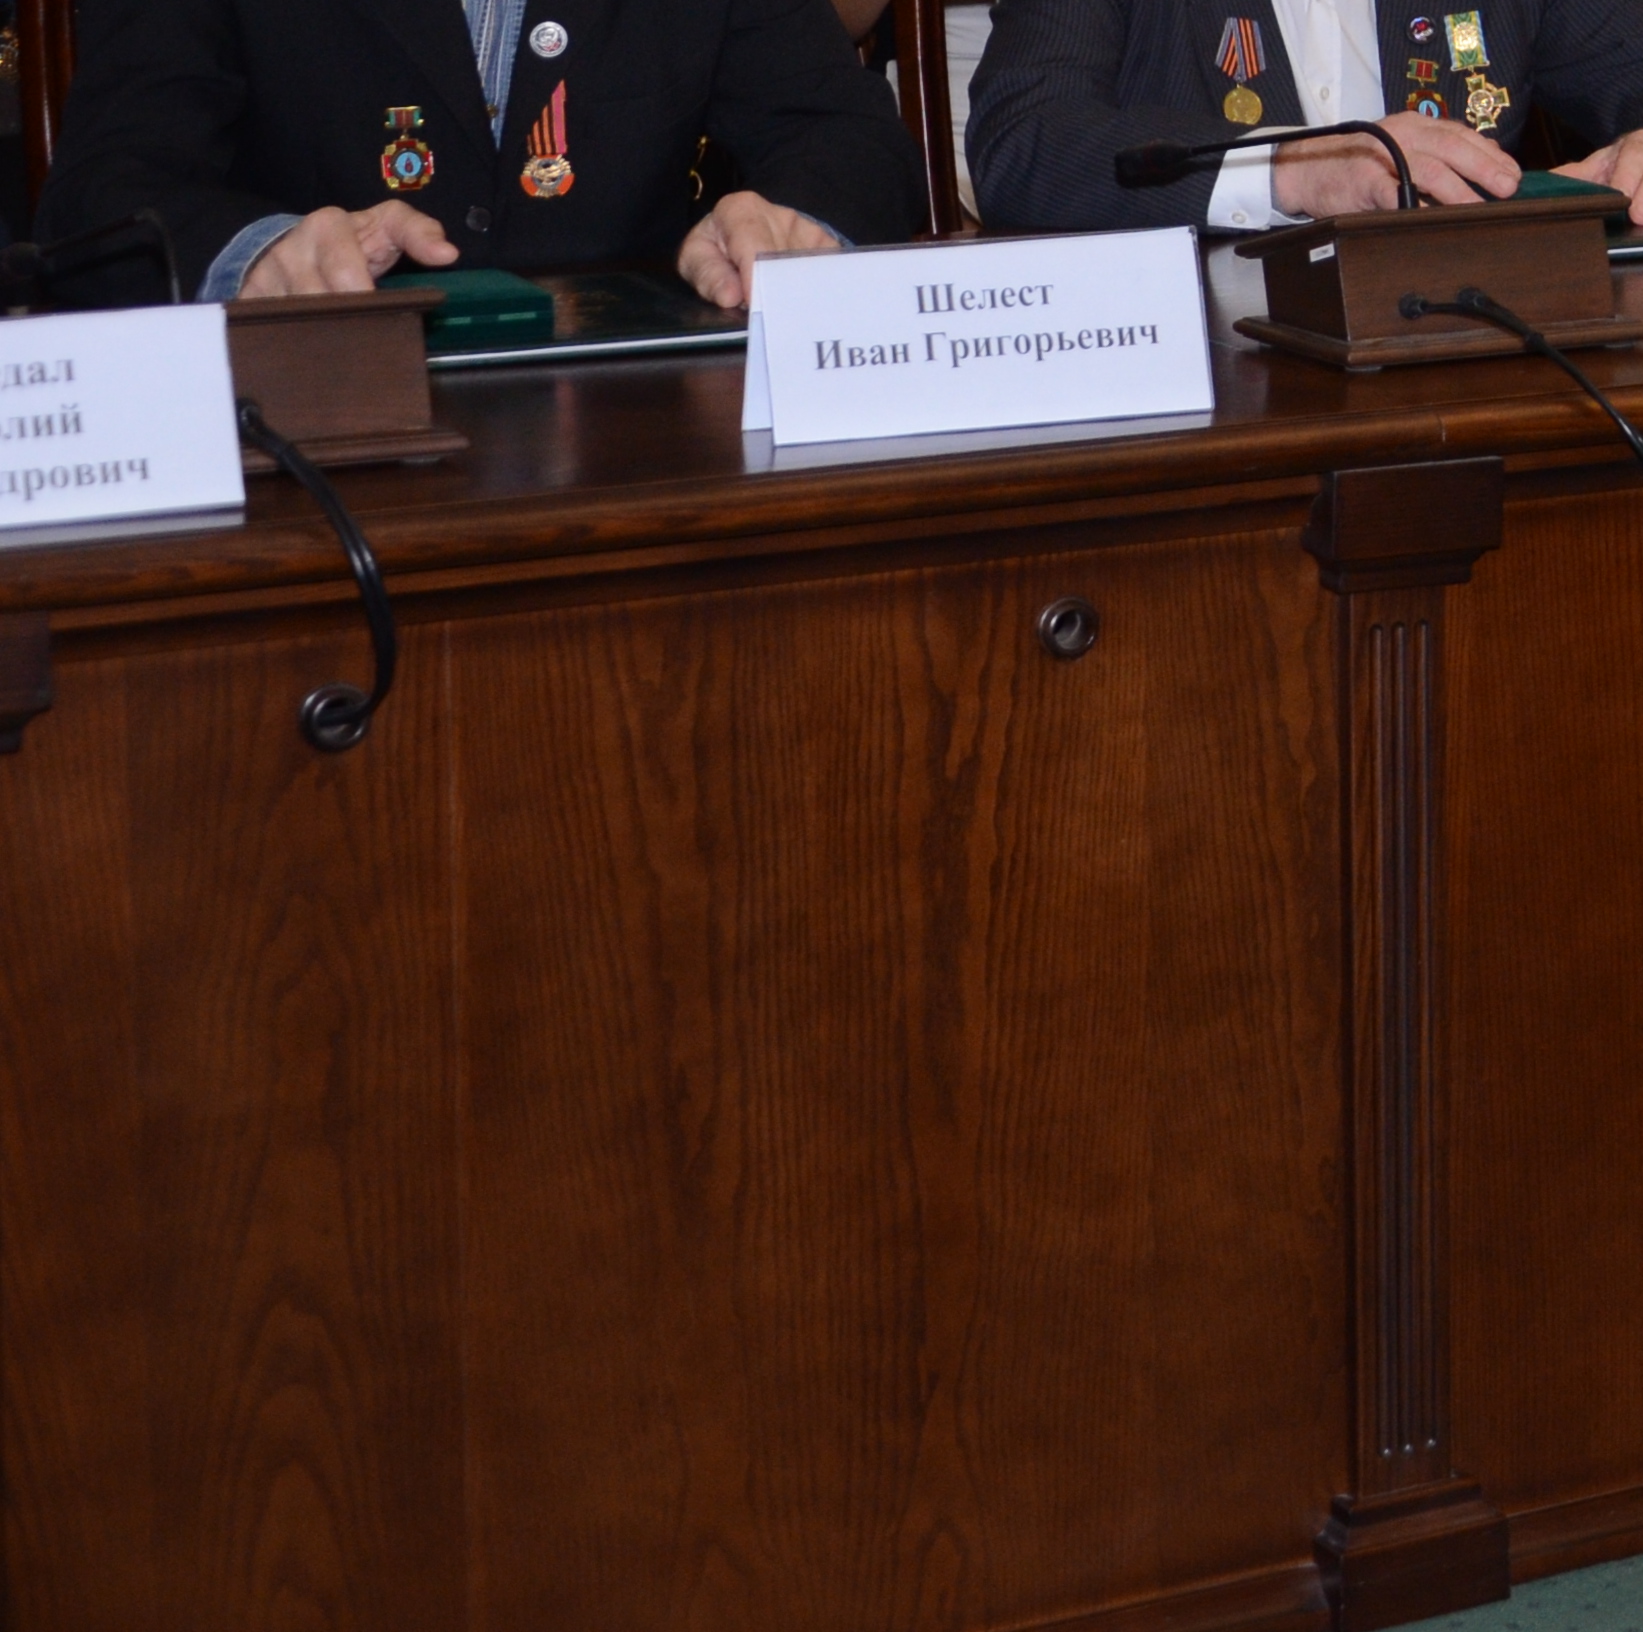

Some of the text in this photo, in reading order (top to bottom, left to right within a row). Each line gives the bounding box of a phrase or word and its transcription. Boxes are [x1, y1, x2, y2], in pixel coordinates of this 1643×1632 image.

[915, 282, 1054, 314] Шелест
[814, 324, 1160, 370] Иван Григорьевич
[0, 403, 83, 440] лий
